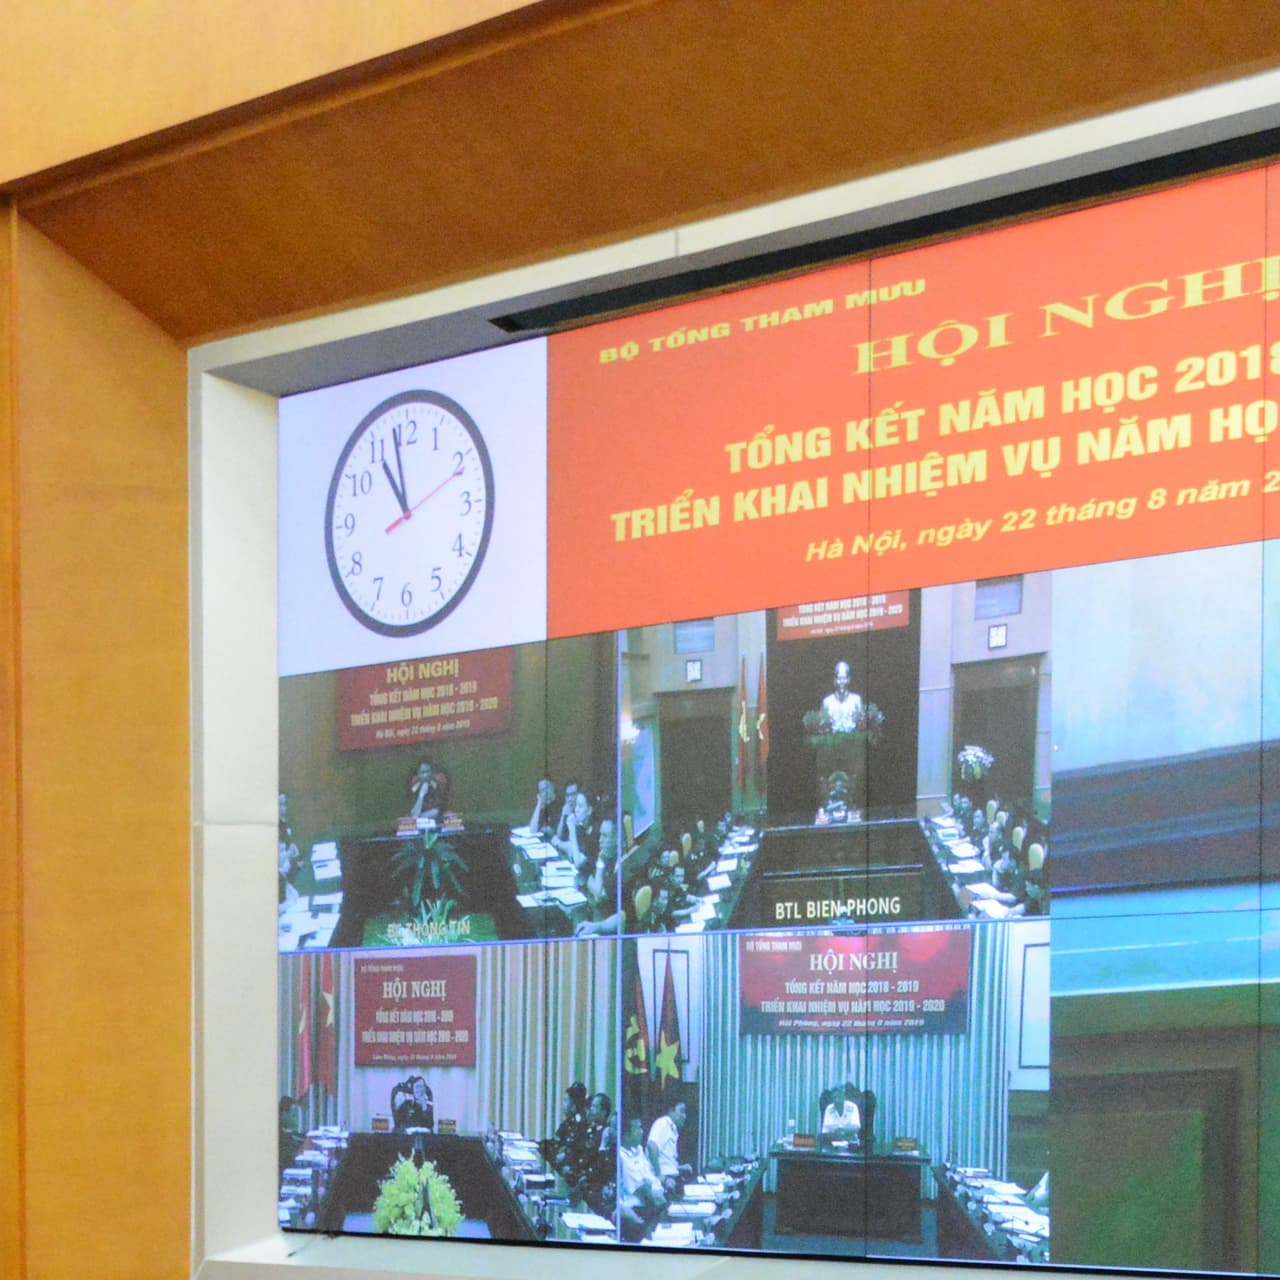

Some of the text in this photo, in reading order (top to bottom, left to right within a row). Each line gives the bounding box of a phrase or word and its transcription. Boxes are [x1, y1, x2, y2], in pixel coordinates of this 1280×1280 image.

[599, 278, 926, 364] BỘ TỔNG THAM MƯU
[851, 312, 1016, 374] HỘI
[725, 425, 831, 473] TỔNG
[845, 402, 925, 452] KẾT
[938, 385, 1045, 438] NĂM
[1060, 363, 1158, 414] HỌC
[397, 420, 418, 447] 12
[432, 427, 440, 451] 1
[370, 439, 385, 464] 11
[453, 451, 464, 475] 2
[351, 470, 372, 497] 10
[610, 488, 721, 542] TRIỂN
[732, 476, 829, 523] KHAI
[842, 450, 988, 502] NHIỆM
[1002, 434, 1062, 486] VỤ
[1076, 414, 1192, 467] NĂM
[460, 491, 471, 517] 3
[344, 513, 355, 536] 9
[805, 539, 843, 562] Hà
[851, 527, 907, 558] Nội,
[917, 517, 992, 548] ngày
[1001, 507, 1037, 532] 22
[1045, 494, 1138, 528] tháng
[1146, 487, 1167, 511] 8
[1176, 477, 1251, 506] năm
[452, 533, 464, 557] 4
[351, 552, 362, 576] 8
[373, 577, 384, 600] 7
[431, 567, 442, 592] 5
[401, 582, 413, 607] 6
[386, 659, 459, 685] HỘI NGHỊ
[775, 897, 901, 920] BTL BIEN PHONG
[809, 949, 898, 975] HỘI NGHỊ
[382, 977, 446, 1002] HỘI NGHỊ
